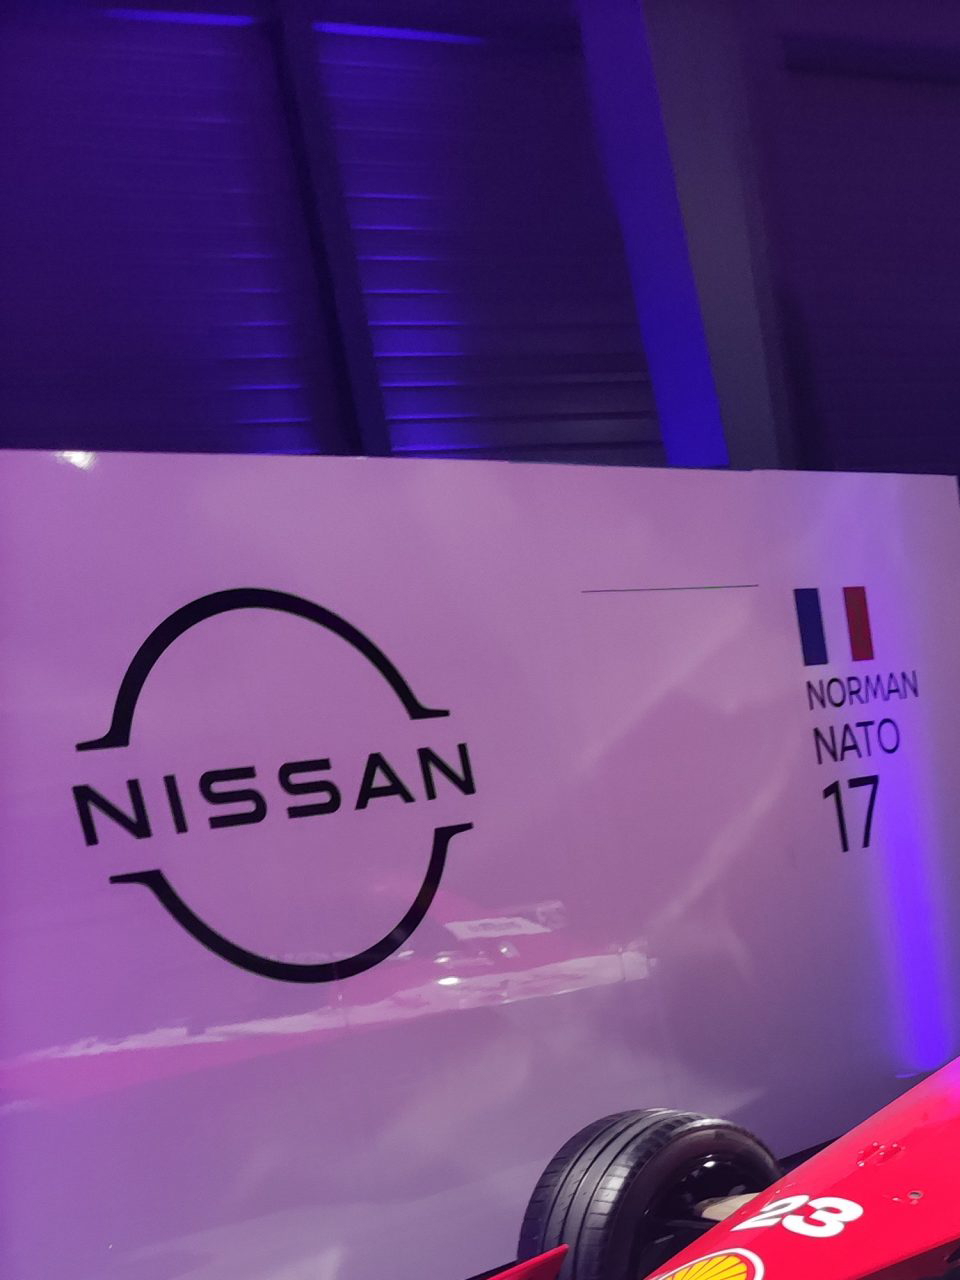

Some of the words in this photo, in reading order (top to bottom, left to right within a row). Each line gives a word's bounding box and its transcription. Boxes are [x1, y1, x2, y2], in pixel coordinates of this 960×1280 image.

[806, 670, 919, 711] NORMAN
[813, 718, 900, 765] NATO
[71, 741, 477, 847] NISSAN
[822, 774, 879, 852] 17
[730, 1195, 864, 1238] 23
